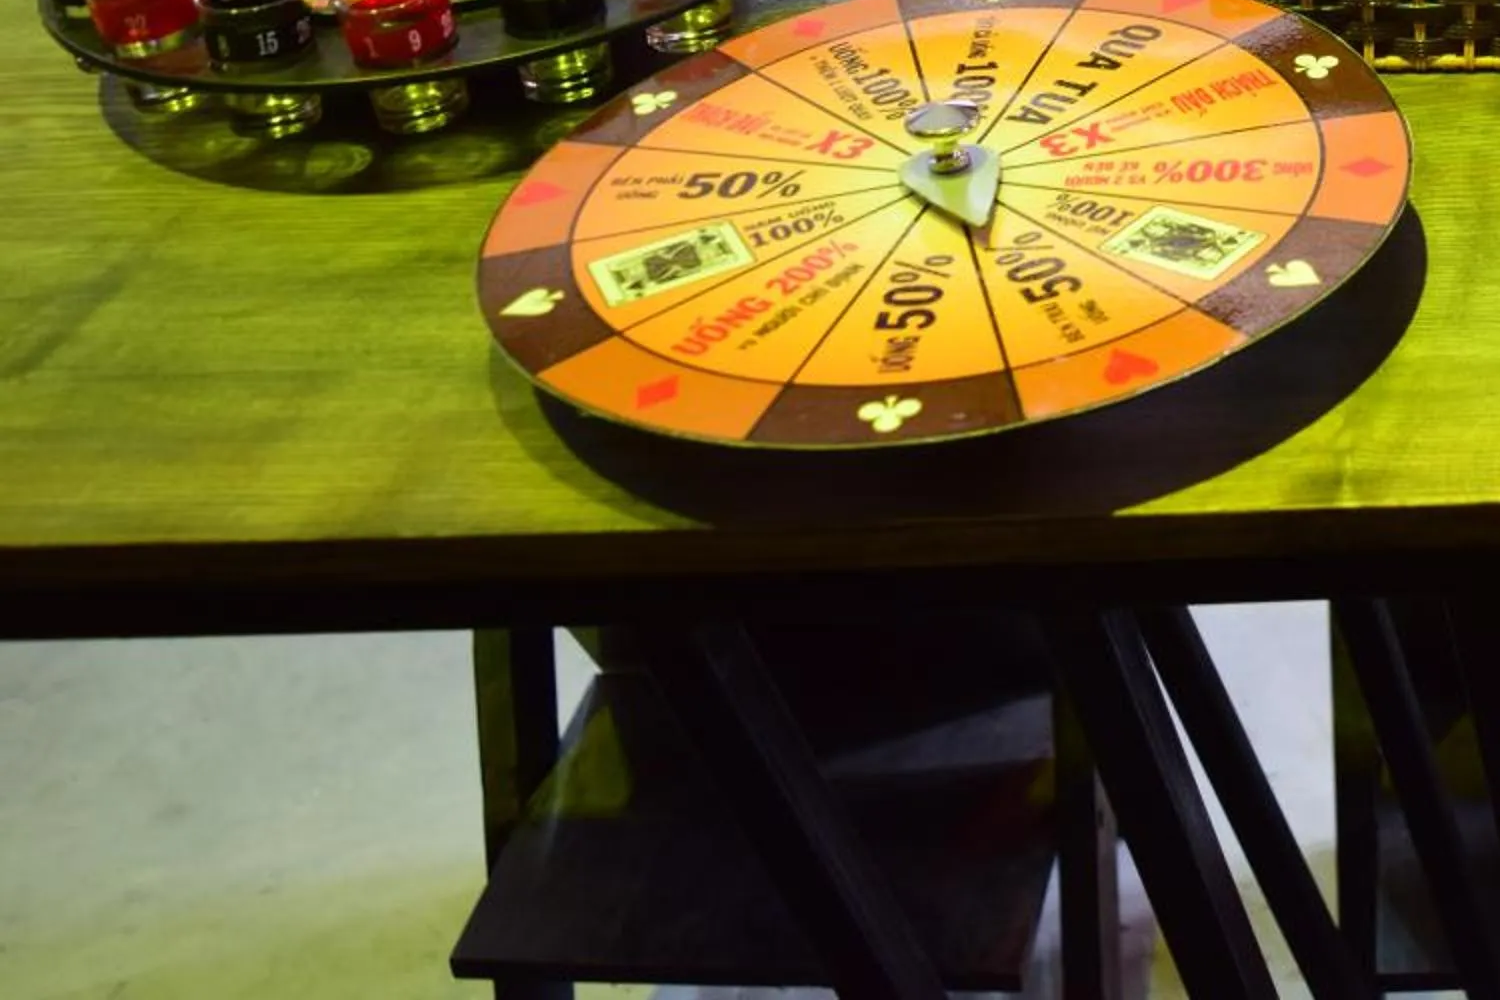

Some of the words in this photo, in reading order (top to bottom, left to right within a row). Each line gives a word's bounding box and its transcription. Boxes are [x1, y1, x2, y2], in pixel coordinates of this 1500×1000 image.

[255, 31, 279, 56] 15
[408, 28, 422, 52] 9
[1077, 24, 1163, 71] QUA
[854, 68, 926, 120] 100%
[949, 61, 998, 106] 100
[1006, 79, 1097, 125] TUA
[805, 130, 879, 160] X3
[1037, 122, 1115, 158] X3
[679, 170, 803, 198] 50%
[1153, 160, 1265, 183] 300%
[1052, 193, 1133, 226] 100%
[749, 210, 844, 247] 100%
[984, 232, 1082, 304] 50%
[669, 296, 771, 355] UỐNG
[763, 242, 856, 295] 200%
[875, 255, 952, 330] 50%
